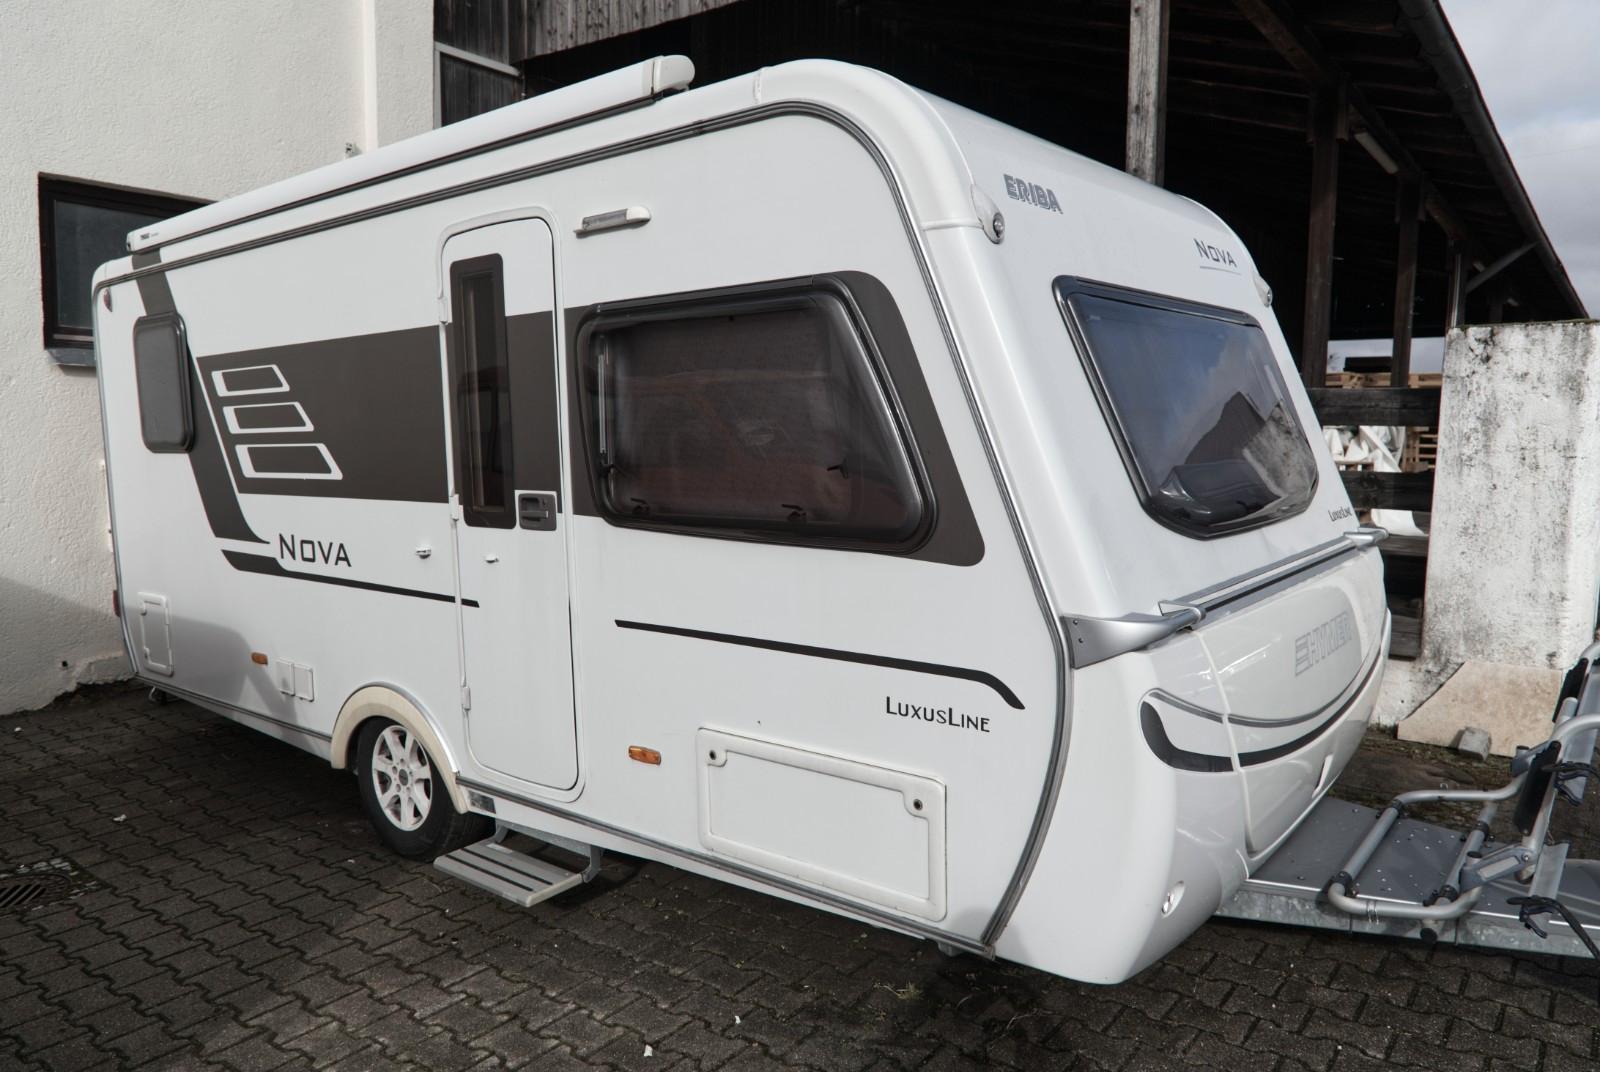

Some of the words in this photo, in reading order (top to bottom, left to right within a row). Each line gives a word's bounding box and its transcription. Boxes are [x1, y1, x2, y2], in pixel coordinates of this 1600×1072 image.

[1003, 173, 1064, 215] ERIBA
[1193, 238, 1238, 268] NOVA
[278, 532, 352, 568] NOVA
[886, 696, 990, 733] LUXUSLINE
